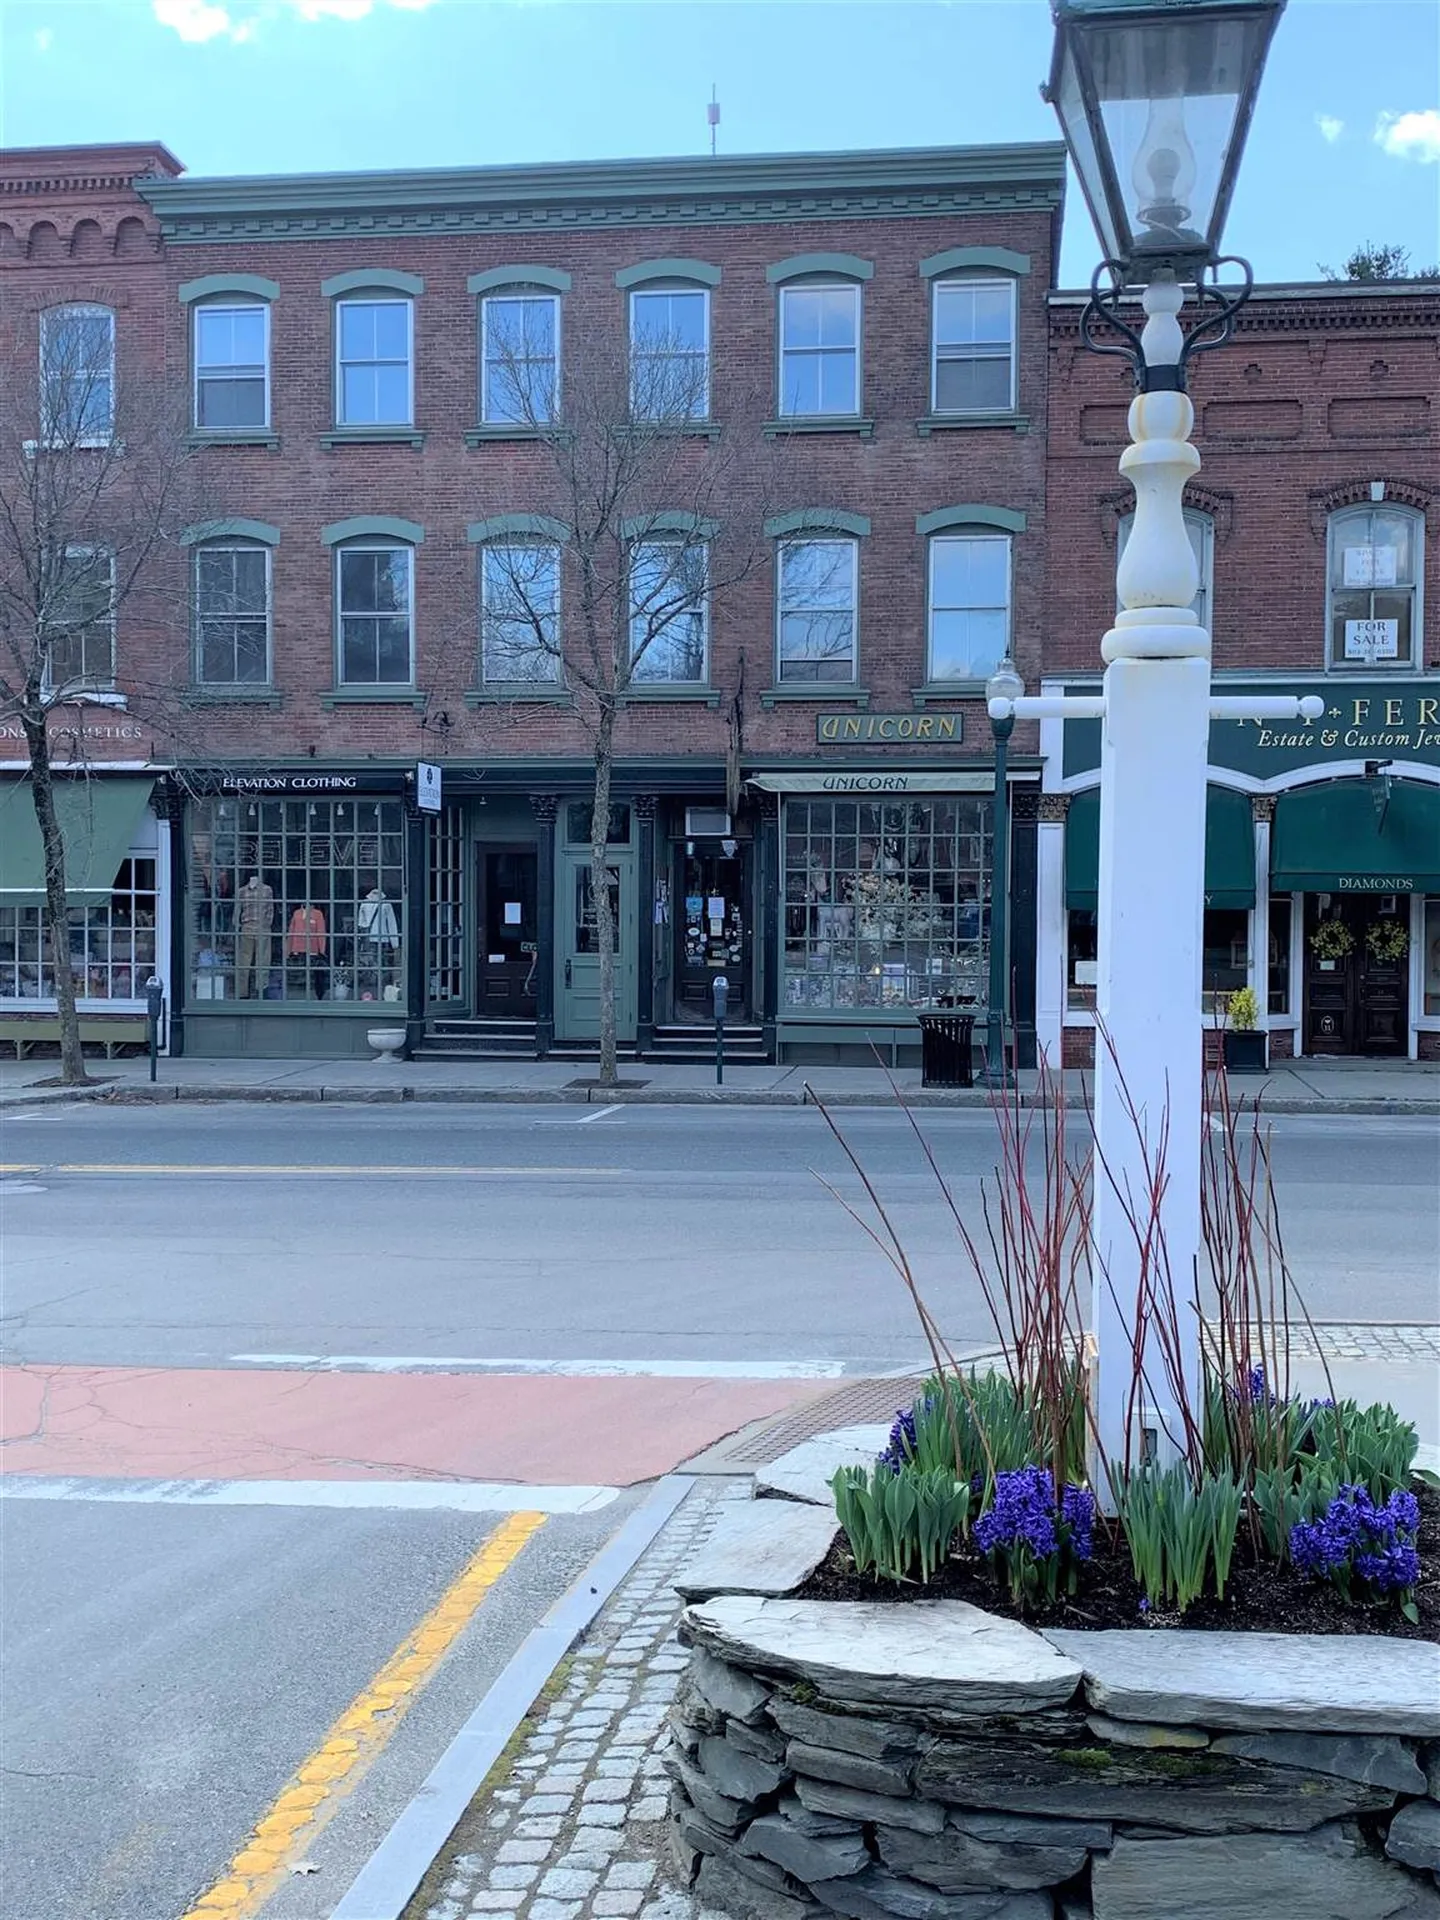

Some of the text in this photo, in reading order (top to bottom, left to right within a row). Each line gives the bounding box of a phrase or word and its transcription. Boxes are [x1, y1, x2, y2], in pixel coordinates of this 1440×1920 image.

[1357, 622, 1386, 632] FOR
[1353, 635, 1390, 646] SALE
[49, 726, 142, 738] COSMETICS
[822, 717, 956, 738] UNICORN
[1257, 729, 1315, 747] Estate
[1320, 729, 1339, 747] &
[1344, 729, 1410, 747] Custom
[222, 777, 357, 788] ELEVATION CLOTHING
[822, 777, 908, 790] UNICORN
[1339, 878, 1413, 889] DIAMONDS
